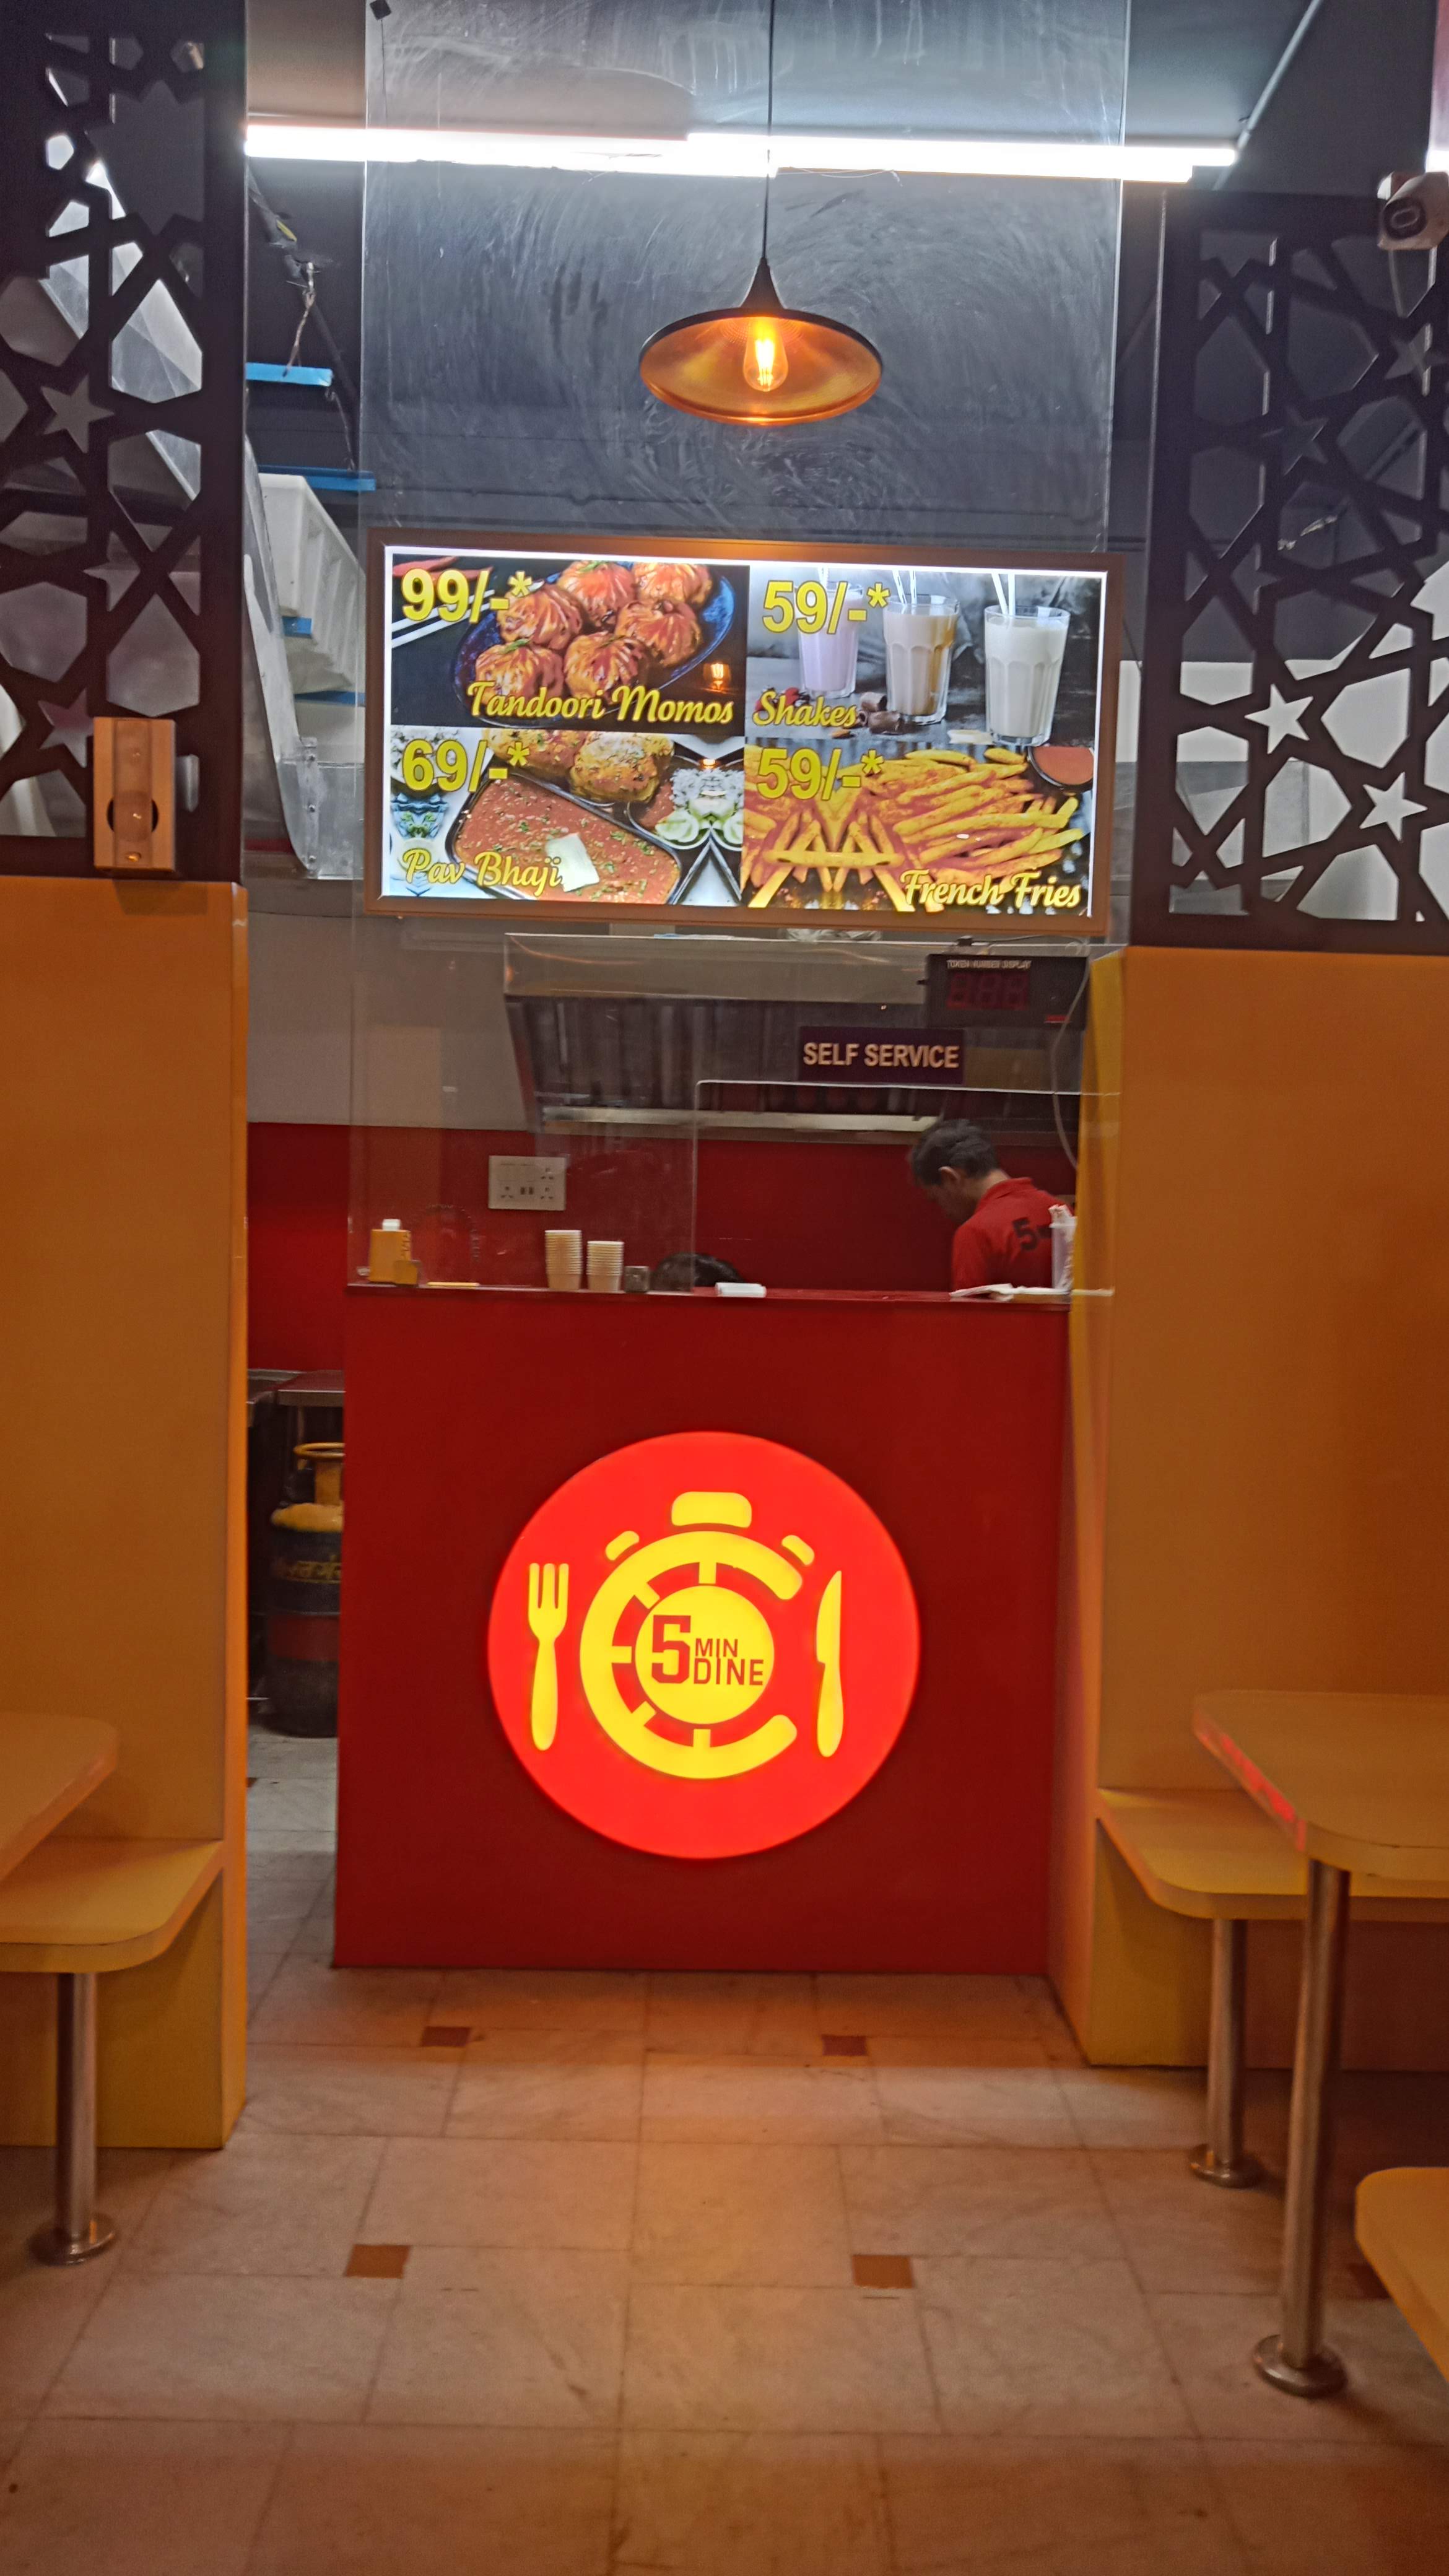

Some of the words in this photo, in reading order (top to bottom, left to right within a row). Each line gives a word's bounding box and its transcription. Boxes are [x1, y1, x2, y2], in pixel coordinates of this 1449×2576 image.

[467, 681, 606, 720] Tandoori
[611, 685, 734, 723] Momos
[752, 690, 857, 728] Shakes
[402, 849, 466, 883] Pav
[473, 851, 562, 896] Bhaji
[899, 868, 1006, 907] French
[1007, 871, 1081, 908] Fries
[803, 1042, 859, 1066] SELF
[864, 1043, 960, 1068] SERVICE
[1012, 1217, 1038, 1251] 5
[651, 1614, 691, 1684] 5
[695, 1638, 738, 1658] MIN
[694, 1658, 764, 1686] DINE
